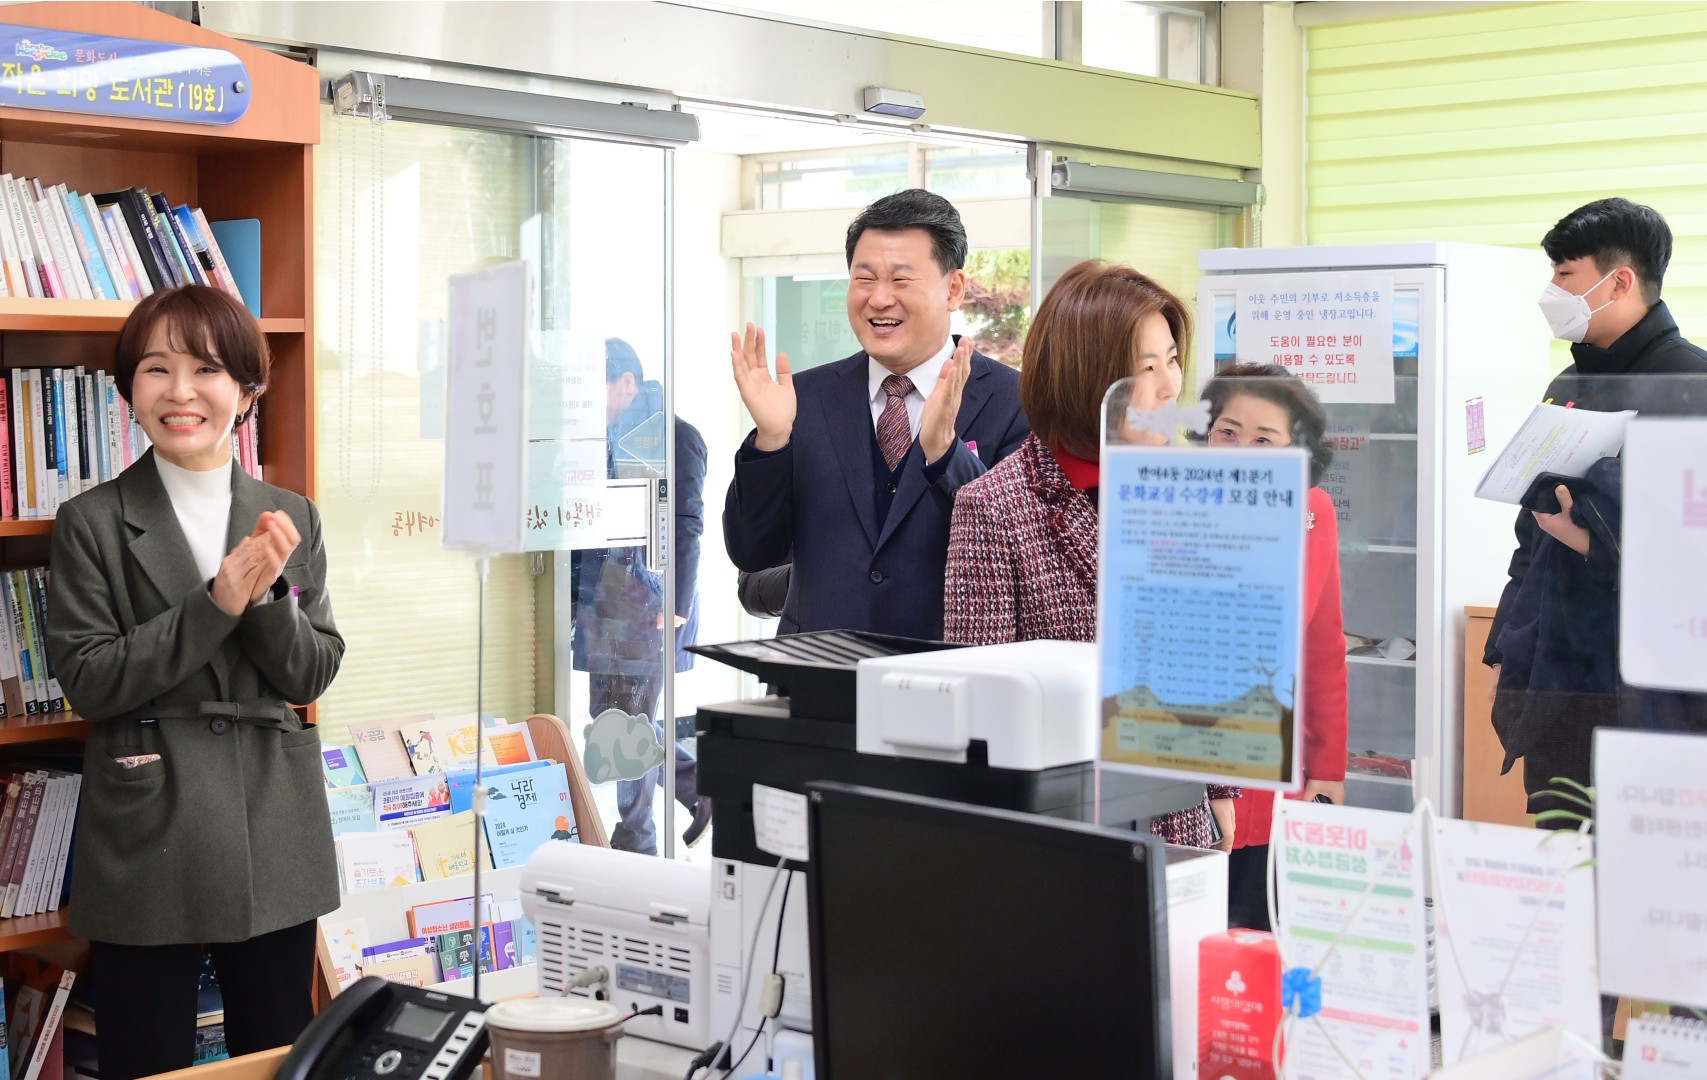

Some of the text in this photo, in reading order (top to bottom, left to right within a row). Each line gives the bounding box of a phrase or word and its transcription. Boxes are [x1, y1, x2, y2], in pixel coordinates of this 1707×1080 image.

[1, 62, 225, 113] 작은 희망 도서관 (19호)
[1249, 291, 1380, 304] 이웃 주민의 기부로 저소득층을
[1251, 308, 1376, 321] 위해 운영 중인 냉장고입니다.
[1270, 335, 1362, 347] 도움이 필요한 분이
[1273, 354, 1355, 366] 이용할 수 있도록
[1137, 466, 1274, 484] 반여4동 2024년 제1분기
[1119, 484, 1294, 508] 문화교실 수강생 모집 안내
[29, 701, 36, 712] 3
[43, 701, 49, 713] 3
[55, 699, 62, 710] 3
[356, 728, 386, 744] K-공감
[510, 778, 534, 794] 나라
[513, 792, 538, 810] 경제
[559, 792, 567, 801] 01
[353, 867, 384, 878] 슬기로운
